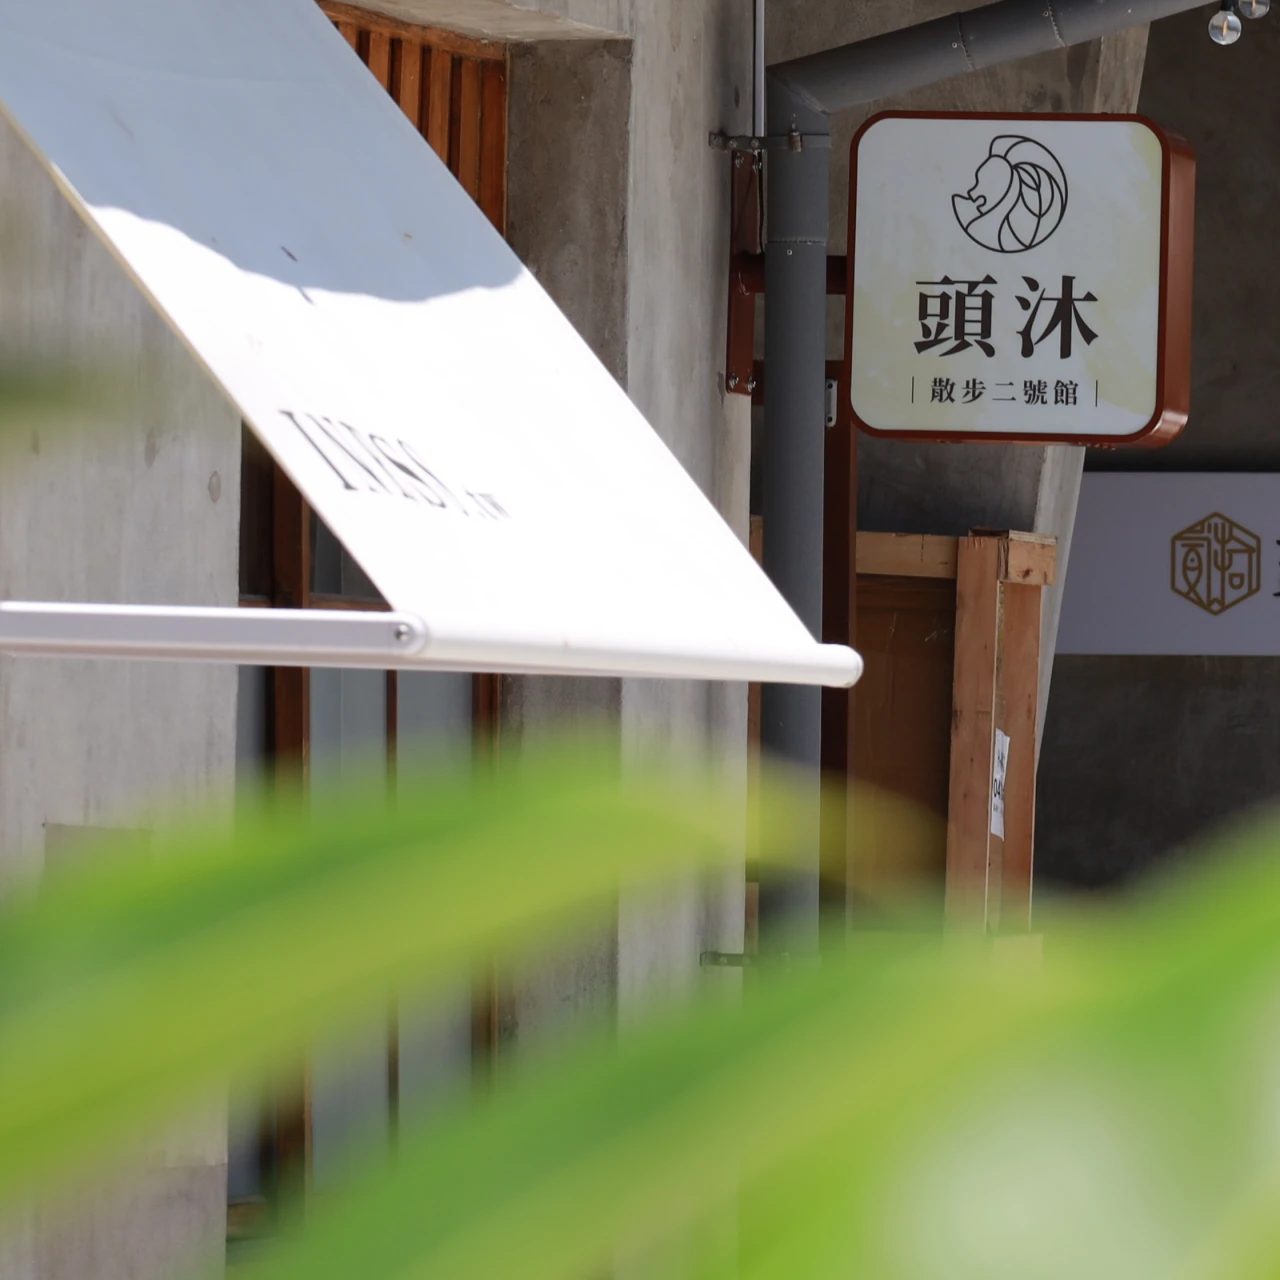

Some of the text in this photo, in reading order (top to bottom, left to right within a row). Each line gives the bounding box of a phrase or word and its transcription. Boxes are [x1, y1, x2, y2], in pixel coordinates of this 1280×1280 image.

[913, 273, 1099, 360] 頭沐
[930, 376, 1080, 407] 散步二號館
